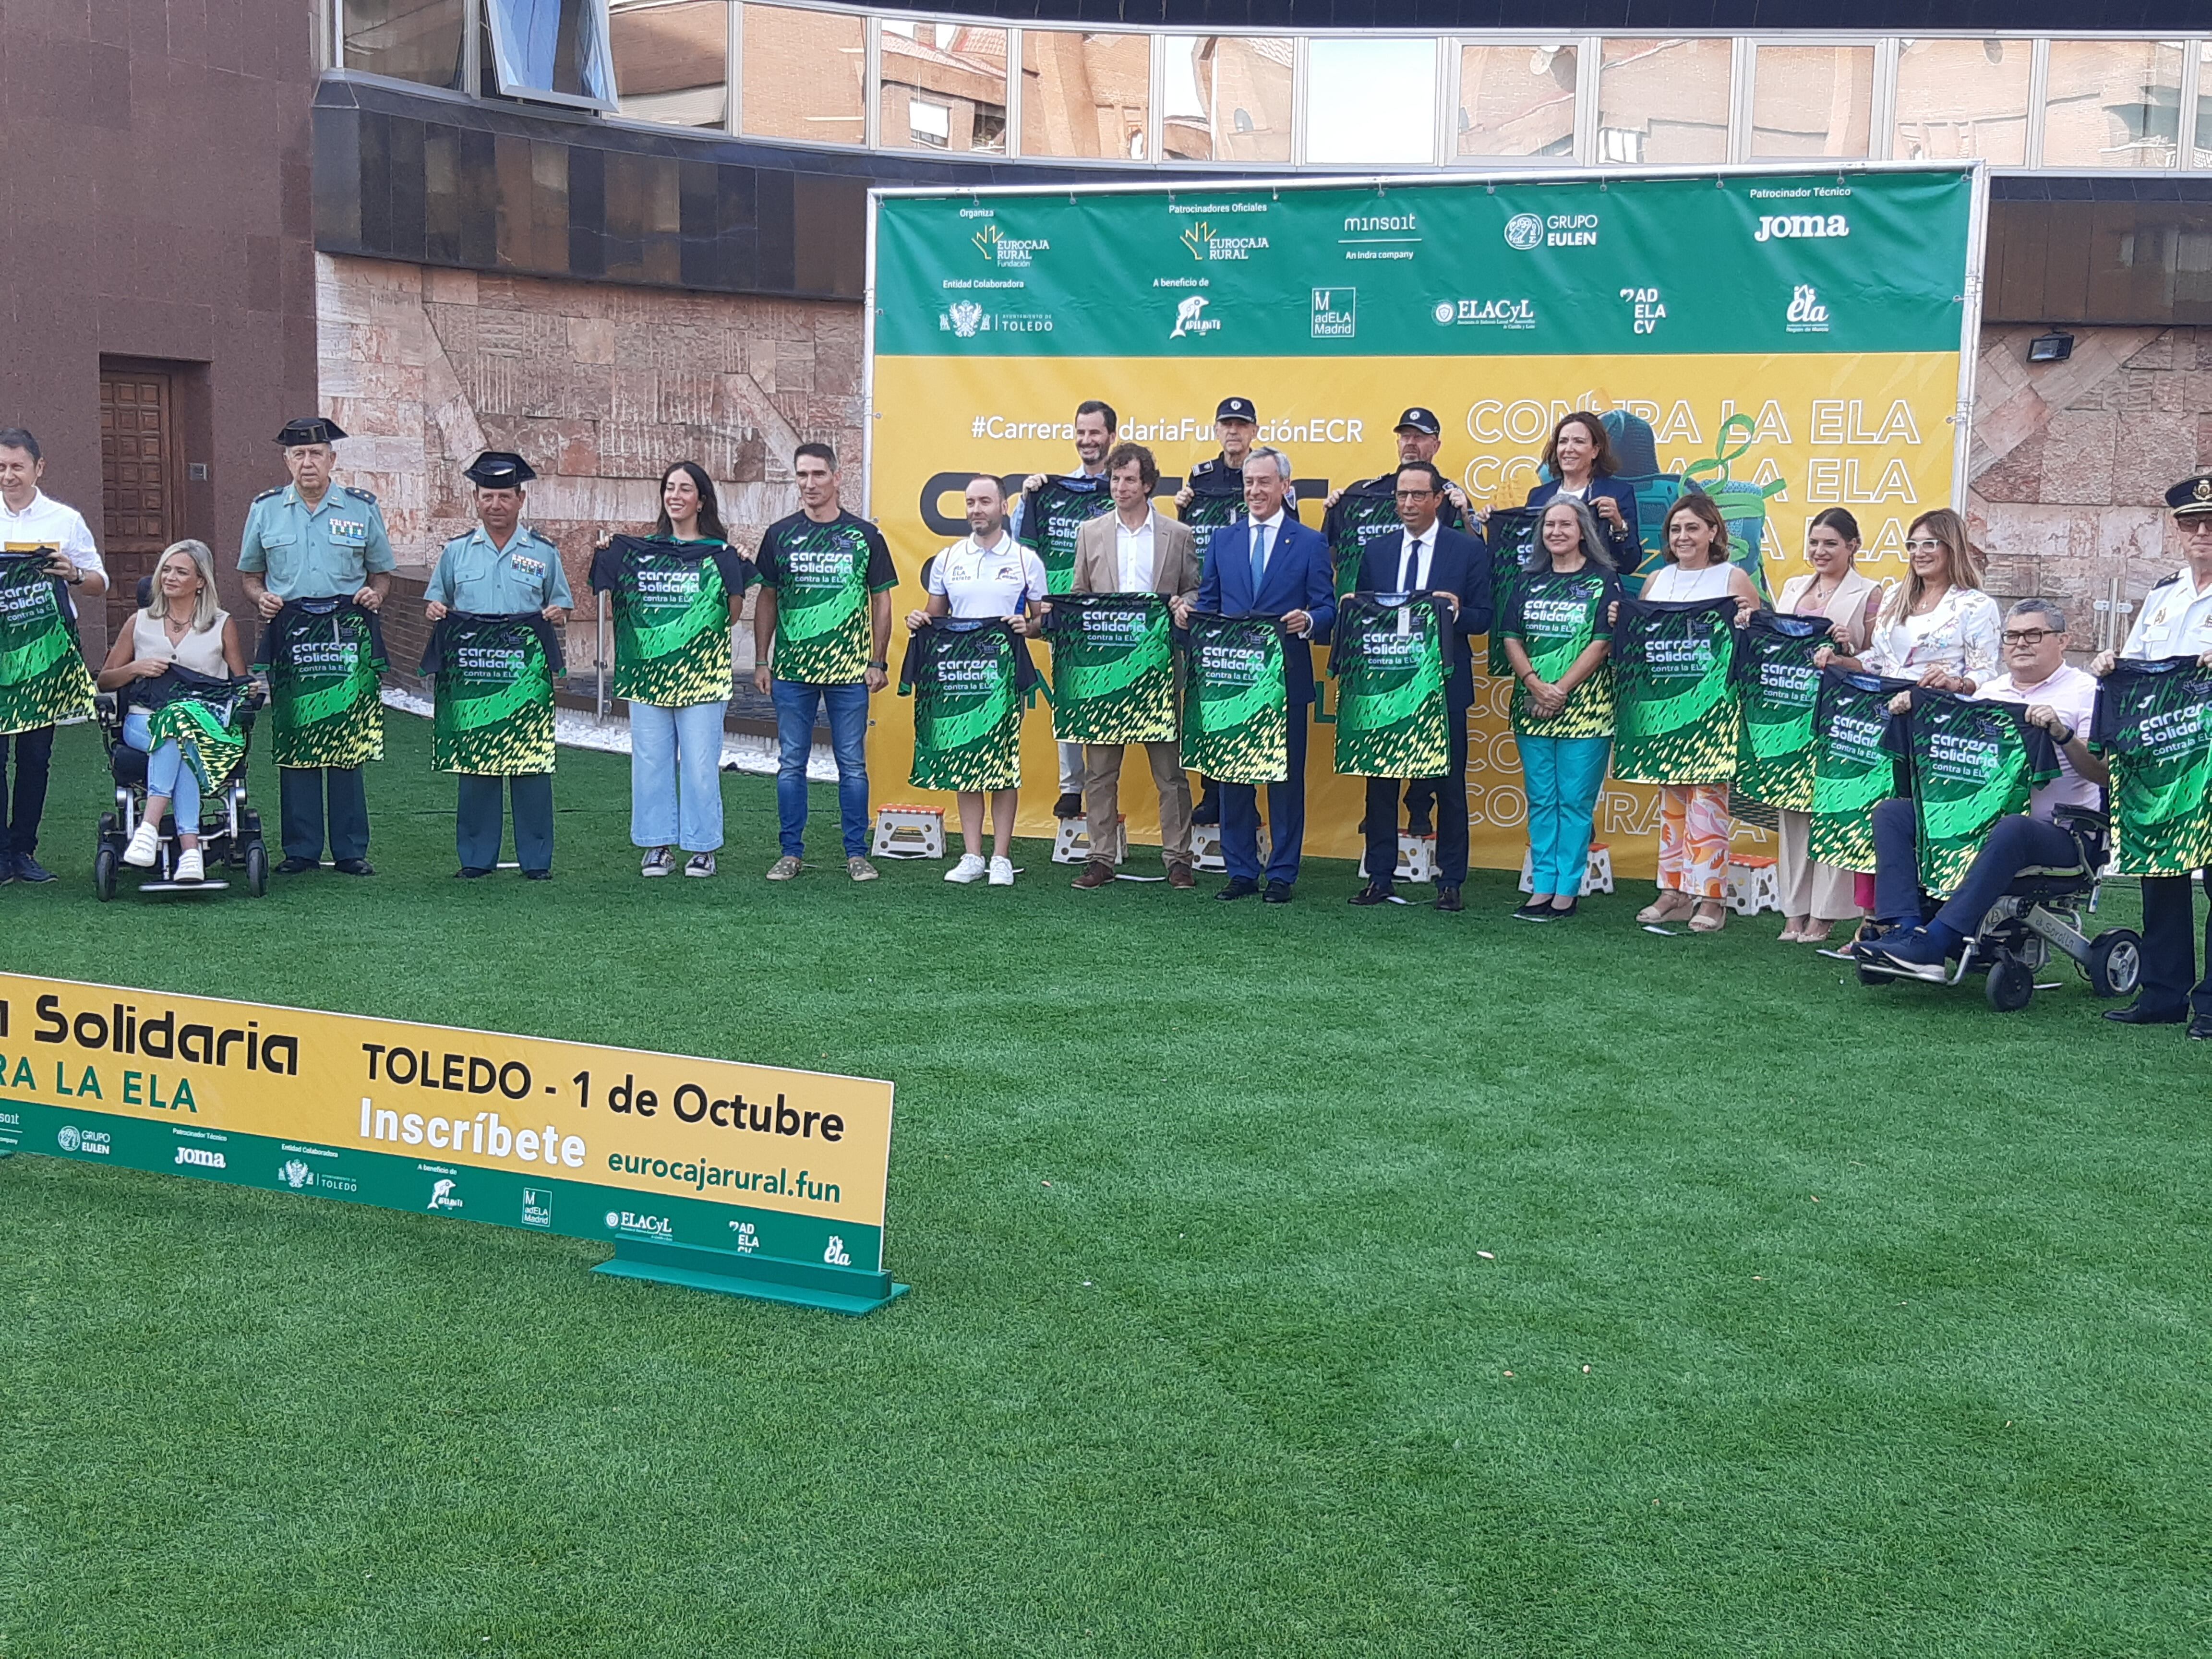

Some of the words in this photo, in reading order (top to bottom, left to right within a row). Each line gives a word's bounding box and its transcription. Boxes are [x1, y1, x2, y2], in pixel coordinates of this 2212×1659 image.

[1750, 188, 1811, 198] Patrocinador
[1813, 187, 1851, 196] Técnico
[960, 209, 994, 218] Organiza
[1169, 204, 1229, 213] Patrocinadores
[1232, 203, 1267, 212] Oficiales
[1345, 214, 1416, 231] minsait
[1547, 215, 1598, 229] GRUPO
[1210, 238, 1269, 249] EUROCAJA
[1547, 232, 1596, 246] EULEN
[998, 240, 1049, 250] EUROCAJA
[998, 250, 1032, 259] RURAL
[1210, 250, 1248, 260] RURAL
[1379, 252, 1413, 260] company
[974, 279, 1024, 288] Colaboradora
[1153, 279, 1159, 287] A
[1161, 278, 1197, 287] beneficio
[1635, 288, 1658, 302] AD
[1787, 285, 1829, 322] ela
[1458, 300, 1533, 323] ELACyL
[1635, 304, 1666, 318] ELA
[1315, 312, 1351, 323] adELA
[1002, 322, 1053, 331] TOLEDO
[1315, 324, 1351, 334] Madrid
[1634, 320, 1655, 334] CV
[1810, 400, 1921, 444] ELA
[1807, 458, 1918, 504] ELA
[1049, 517, 1083, 528] carr
[1048, 527, 1077, 539] Solid
[790, 552, 853, 563] carrera
[790, 562, 853, 573] Solidaria
[638, 571, 699, 581] carrera
[638, 582, 699, 593] Solidaria
[1525, 600, 1587, 612] carrera
[7, 610, 35, 621] contra
[1082, 611, 1146, 621] carrera
[1523, 611, 1585, 623] Solidaria
[1083, 621, 1146, 632] Solidaria
[1363, 632, 1424, 643] carrra
[292, 642, 358, 653] carrera
[1363, 644, 1425, 654] Solidaria
[1645, 639, 1710, 650] carrera
[293, 652, 358, 665] Solidaria
[458, 648, 524, 658] carrera
[1203, 647, 1264, 660] carrera
[1646, 652, 1712, 662] Solidaria
[338, 664, 353, 673] ELA
[459, 658, 525, 669] Solidaria
[938, 660, 998, 670] carrera
[1202, 657, 1264, 672] Solidaria
[938, 670, 998, 681] Solidaria
[1763, 690, 1789, 698] contra
[1931, 733, 1998, 754] carrera
[2152, 740, 2185, 756] contra
[2198, 732, 2212, 742] EL
[1831, 742, 1855, 754] contra
[1857, 747, 1864, 757] la
[1929, 746, 1997, 768] Solidaria
[1932, 763, 1960, 773] contra
[1963, 767, 1970, 775] la
[1973, 769, 1990, 779] ELA
[34, 994, 299, 1076] Solidaria
[56, 1061, 103, 1100] LA
[123, 1070, 197, 1113] ELA
[362, 1043, 531, 1100] TOLEDO
[573, 1071, 589, 1108] 1
[608, 1074, 658, 1117] de
[673, 1083, 844, 1142] Octubre
[82, 1130, 110, 1143] GRUPO
[173, 1128, 205, 1138] Patrocinador
[206, 1132, 227, 1142] Técnico
[360, 1097, 586, 1167] Inscríbete
[82, 1142, 109, 1154] EULEN
[282, 1144, 301, 1152] Entidad
[302, 1147, 338, 1157] Colaboradora
[423, 1166, 449, 1174] beneficio
[608, 1153, 841, 1203] eurocajarural.fun
[322, 1179, 357, 1191] TOLEDO
[525, 1206, 548, 1215] adELA
[524, 1214, 548, 1225] Madrid
[621, 1212, 672, 1234] ELACyL
[739, 1223, 755, 1234] AD
[738, 1234, 759, 1247] ELA
[824, 1236, 852, 1266] ela
